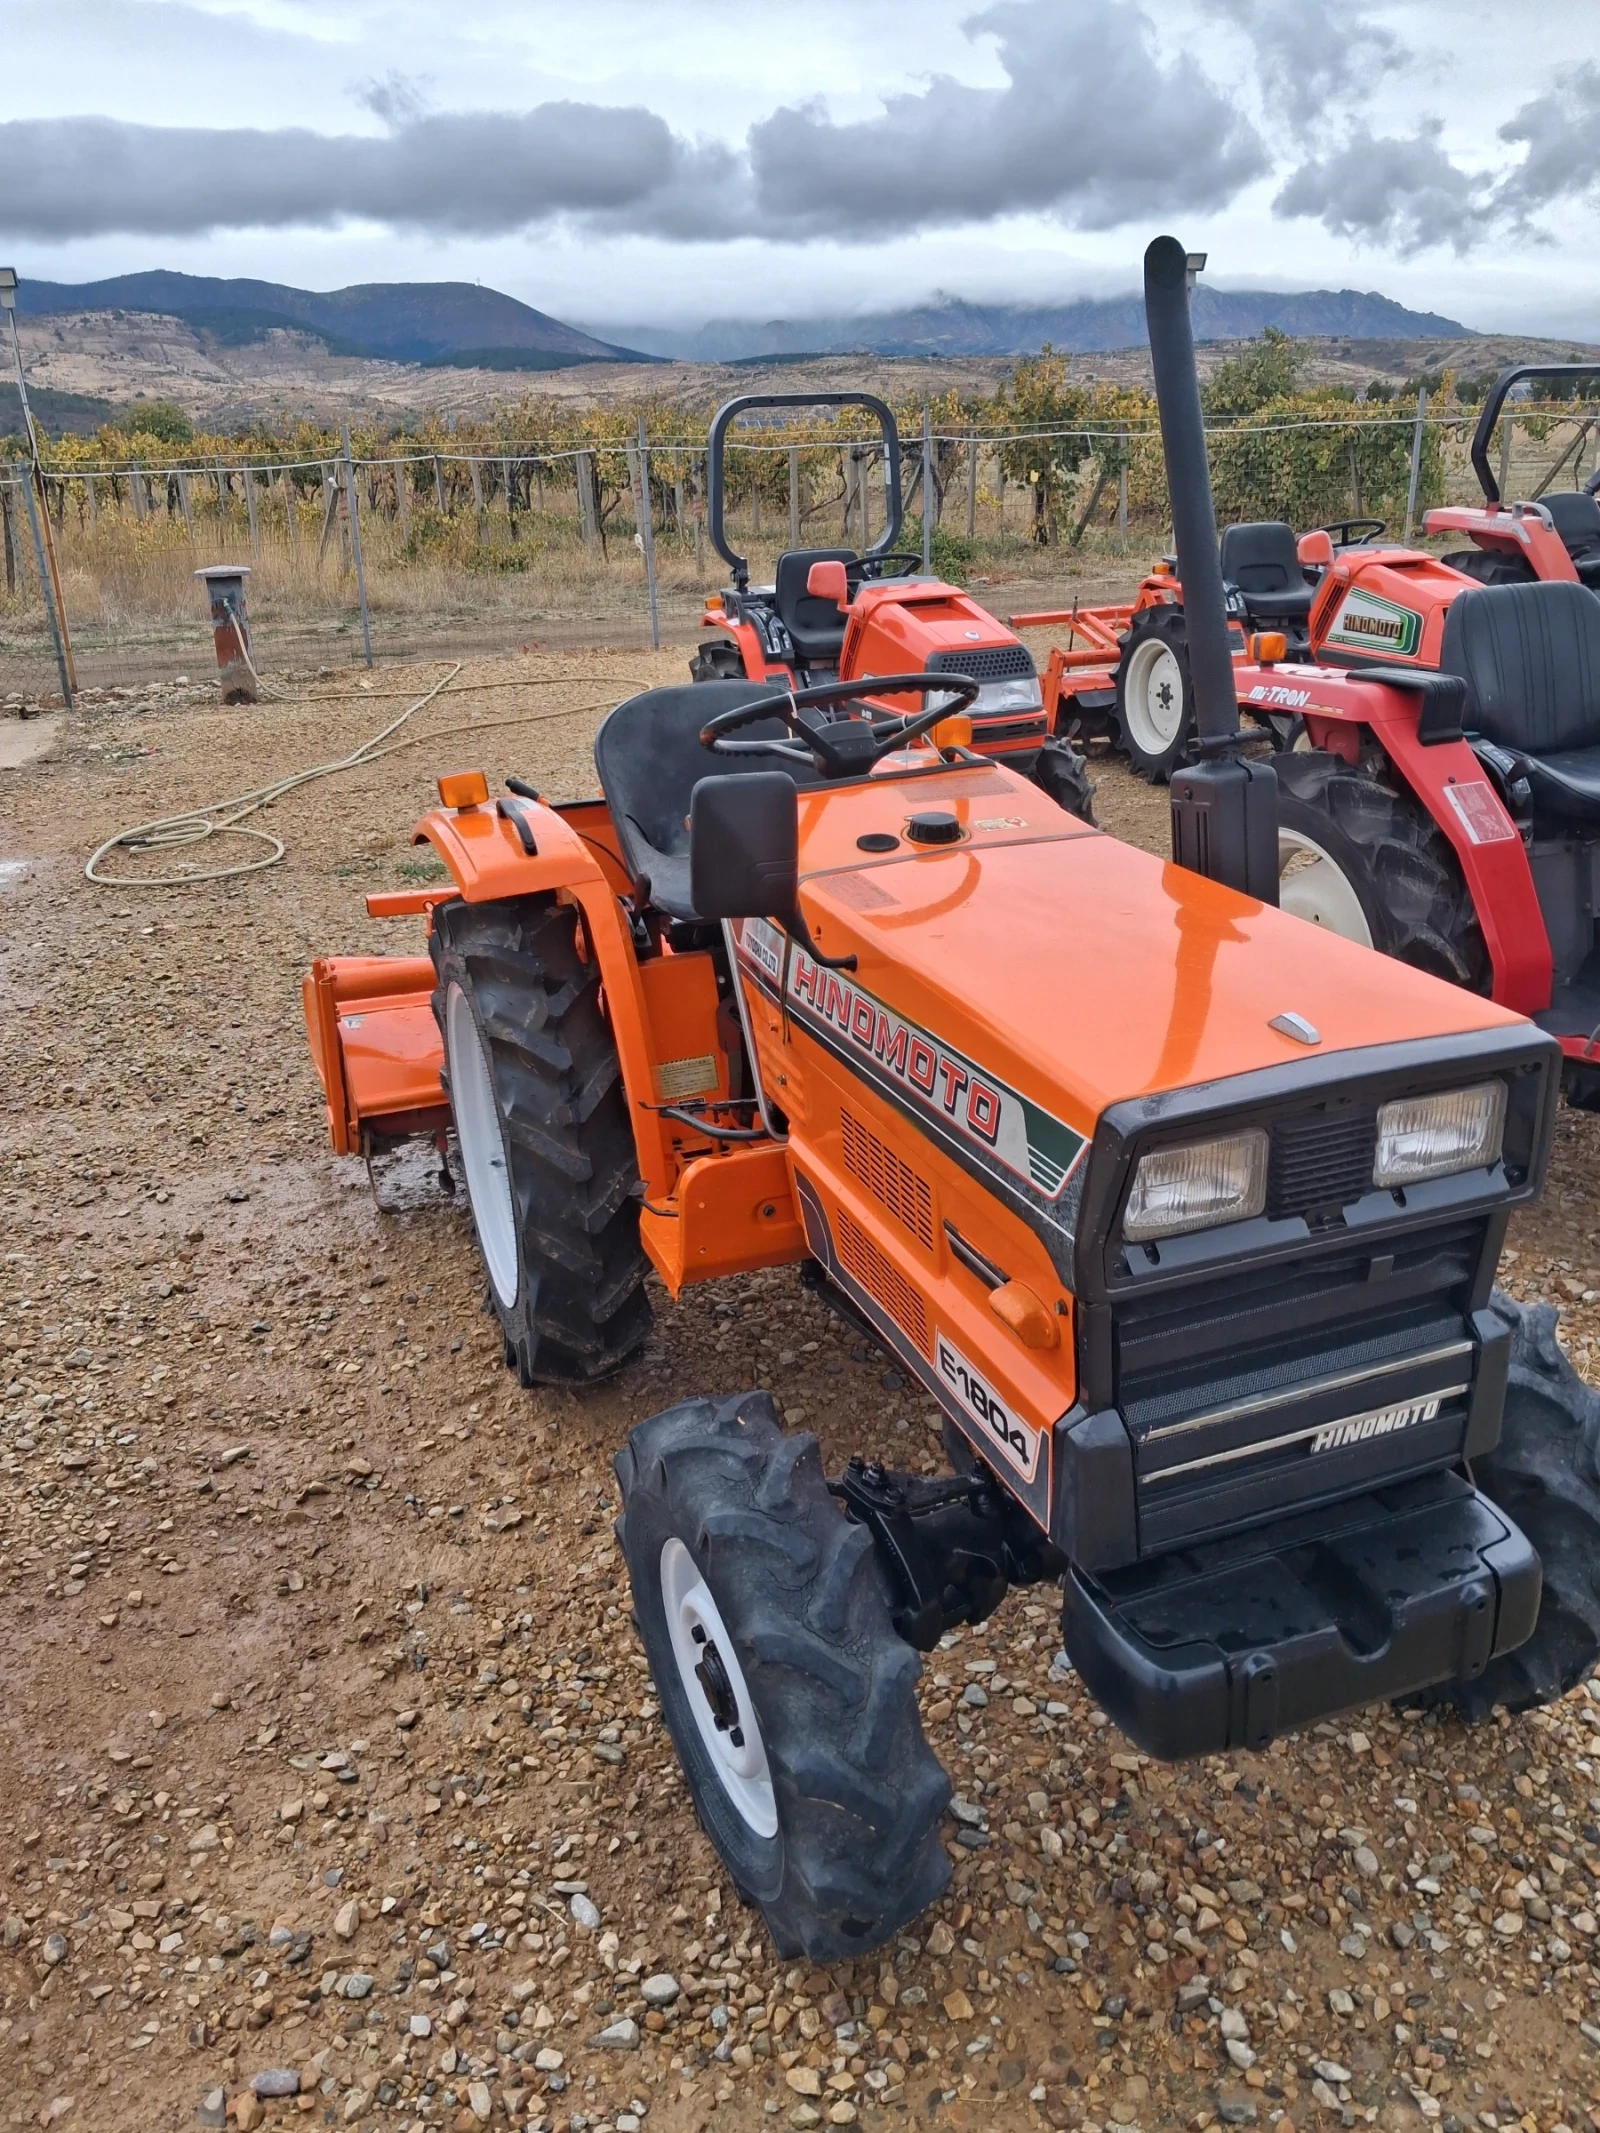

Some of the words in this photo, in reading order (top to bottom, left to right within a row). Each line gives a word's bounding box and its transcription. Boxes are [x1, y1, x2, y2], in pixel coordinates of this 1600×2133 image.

[1343, 613, 1403, 640] HINOMOTO
[794, 952, 1001, 1147] HINOMOTO
[939, 1342, 1031, 1467] E1804
[1311, 1399, 1441, 1453] HINOMOTO
